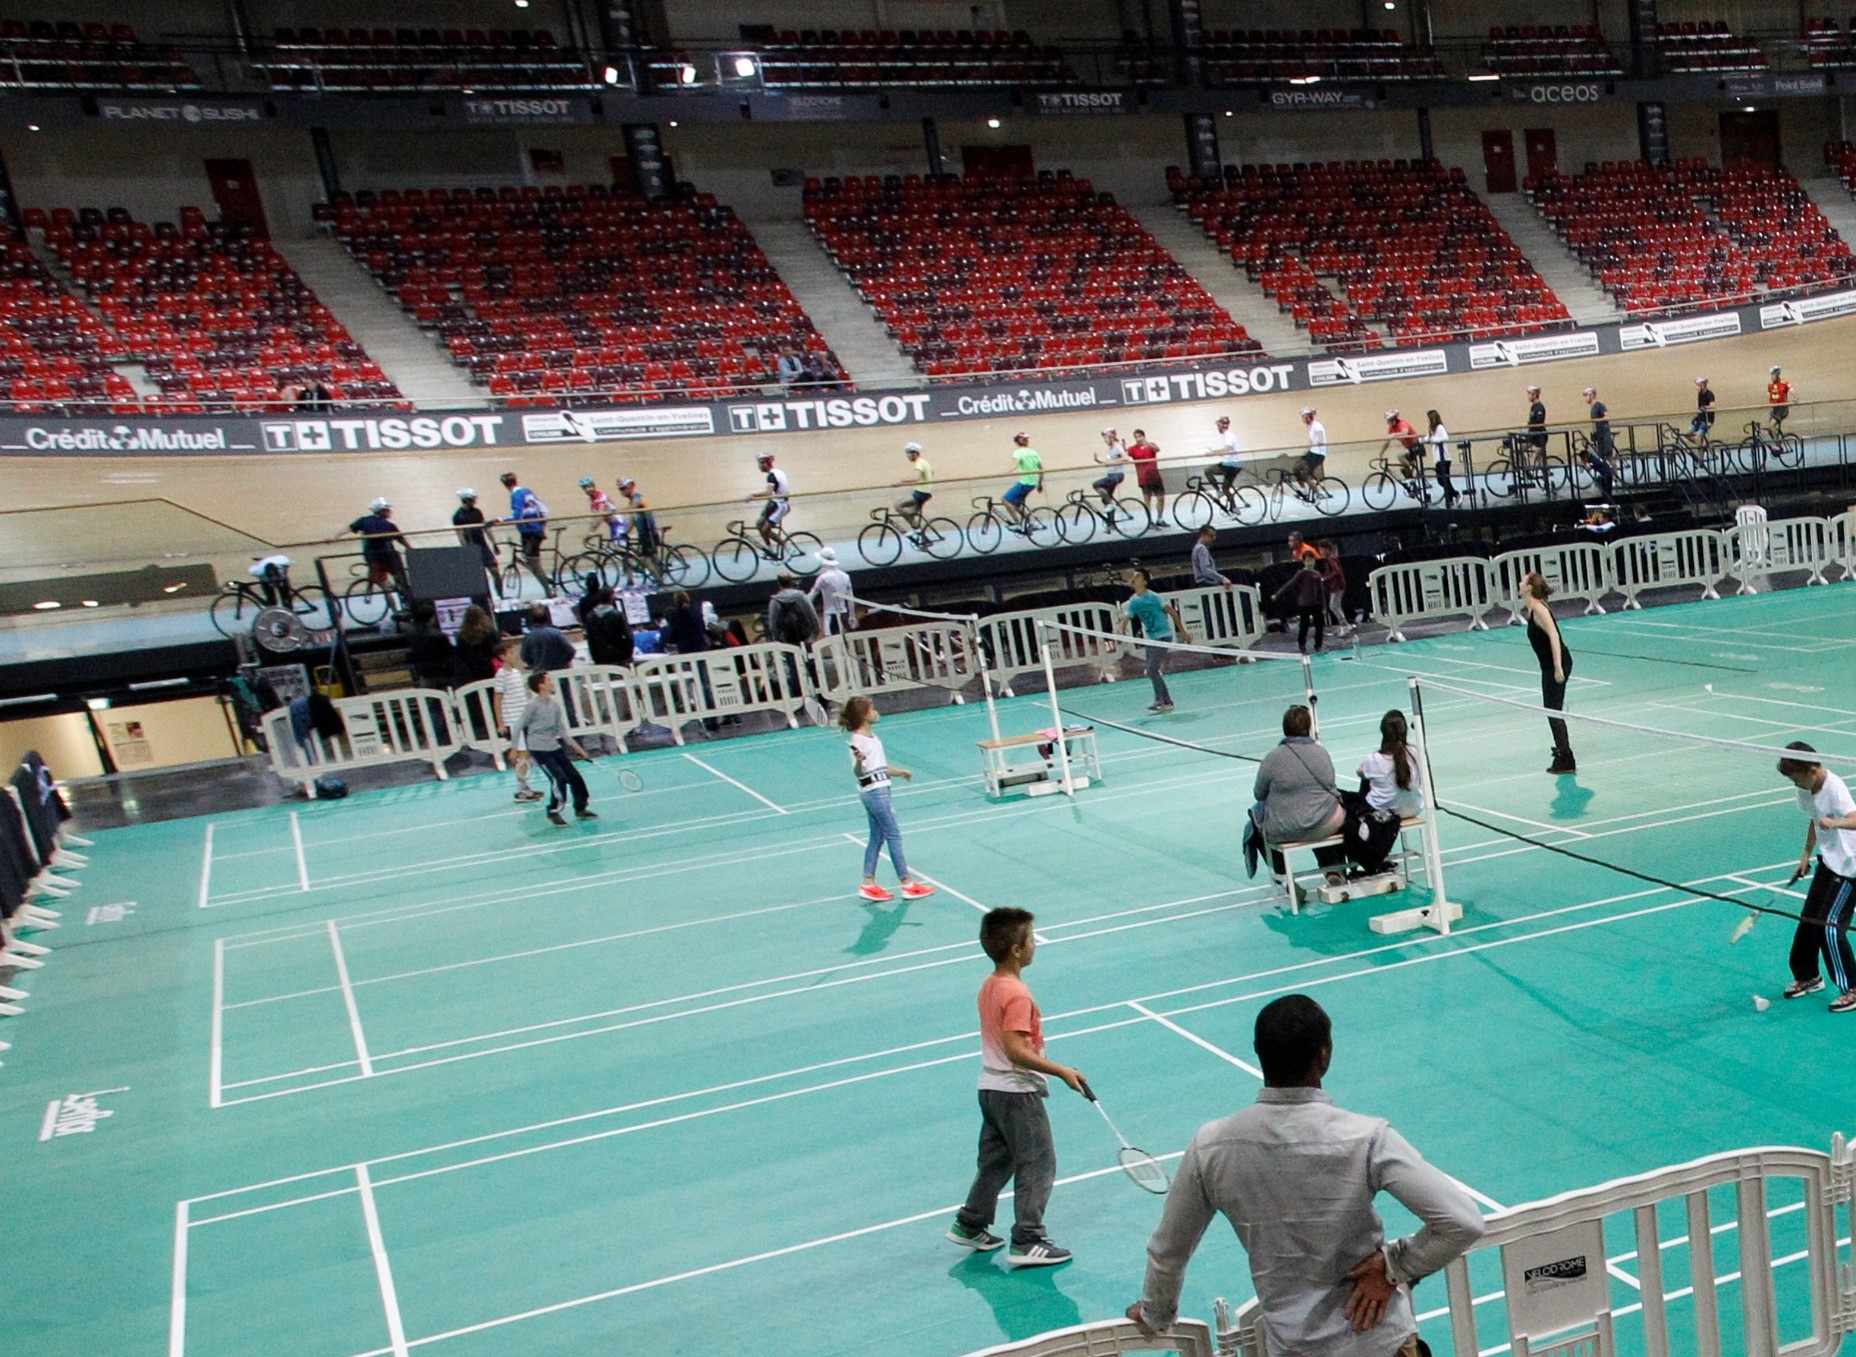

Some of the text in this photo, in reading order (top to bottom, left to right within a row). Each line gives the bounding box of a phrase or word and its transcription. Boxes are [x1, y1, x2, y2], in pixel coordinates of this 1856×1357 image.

[1061, 93, 1122, 106] TISSOT
[1531, 85, 1599, 103] aceos
[104, 105, 259, 121] PLANET SUSHI
[494, 100, 570, 114] TISSOT
[1170, 364, 1294, 399] TISSOT
[785, 394, 931, 429] TISSOT
[958, 386, 1097, 415] Crédit Mutuel
[25, 427, 226, 450] Crédit Mutuel
[329, 415, 503, 450] TISSOT
[1526, 1257, 1586, 1278] VELODROME
